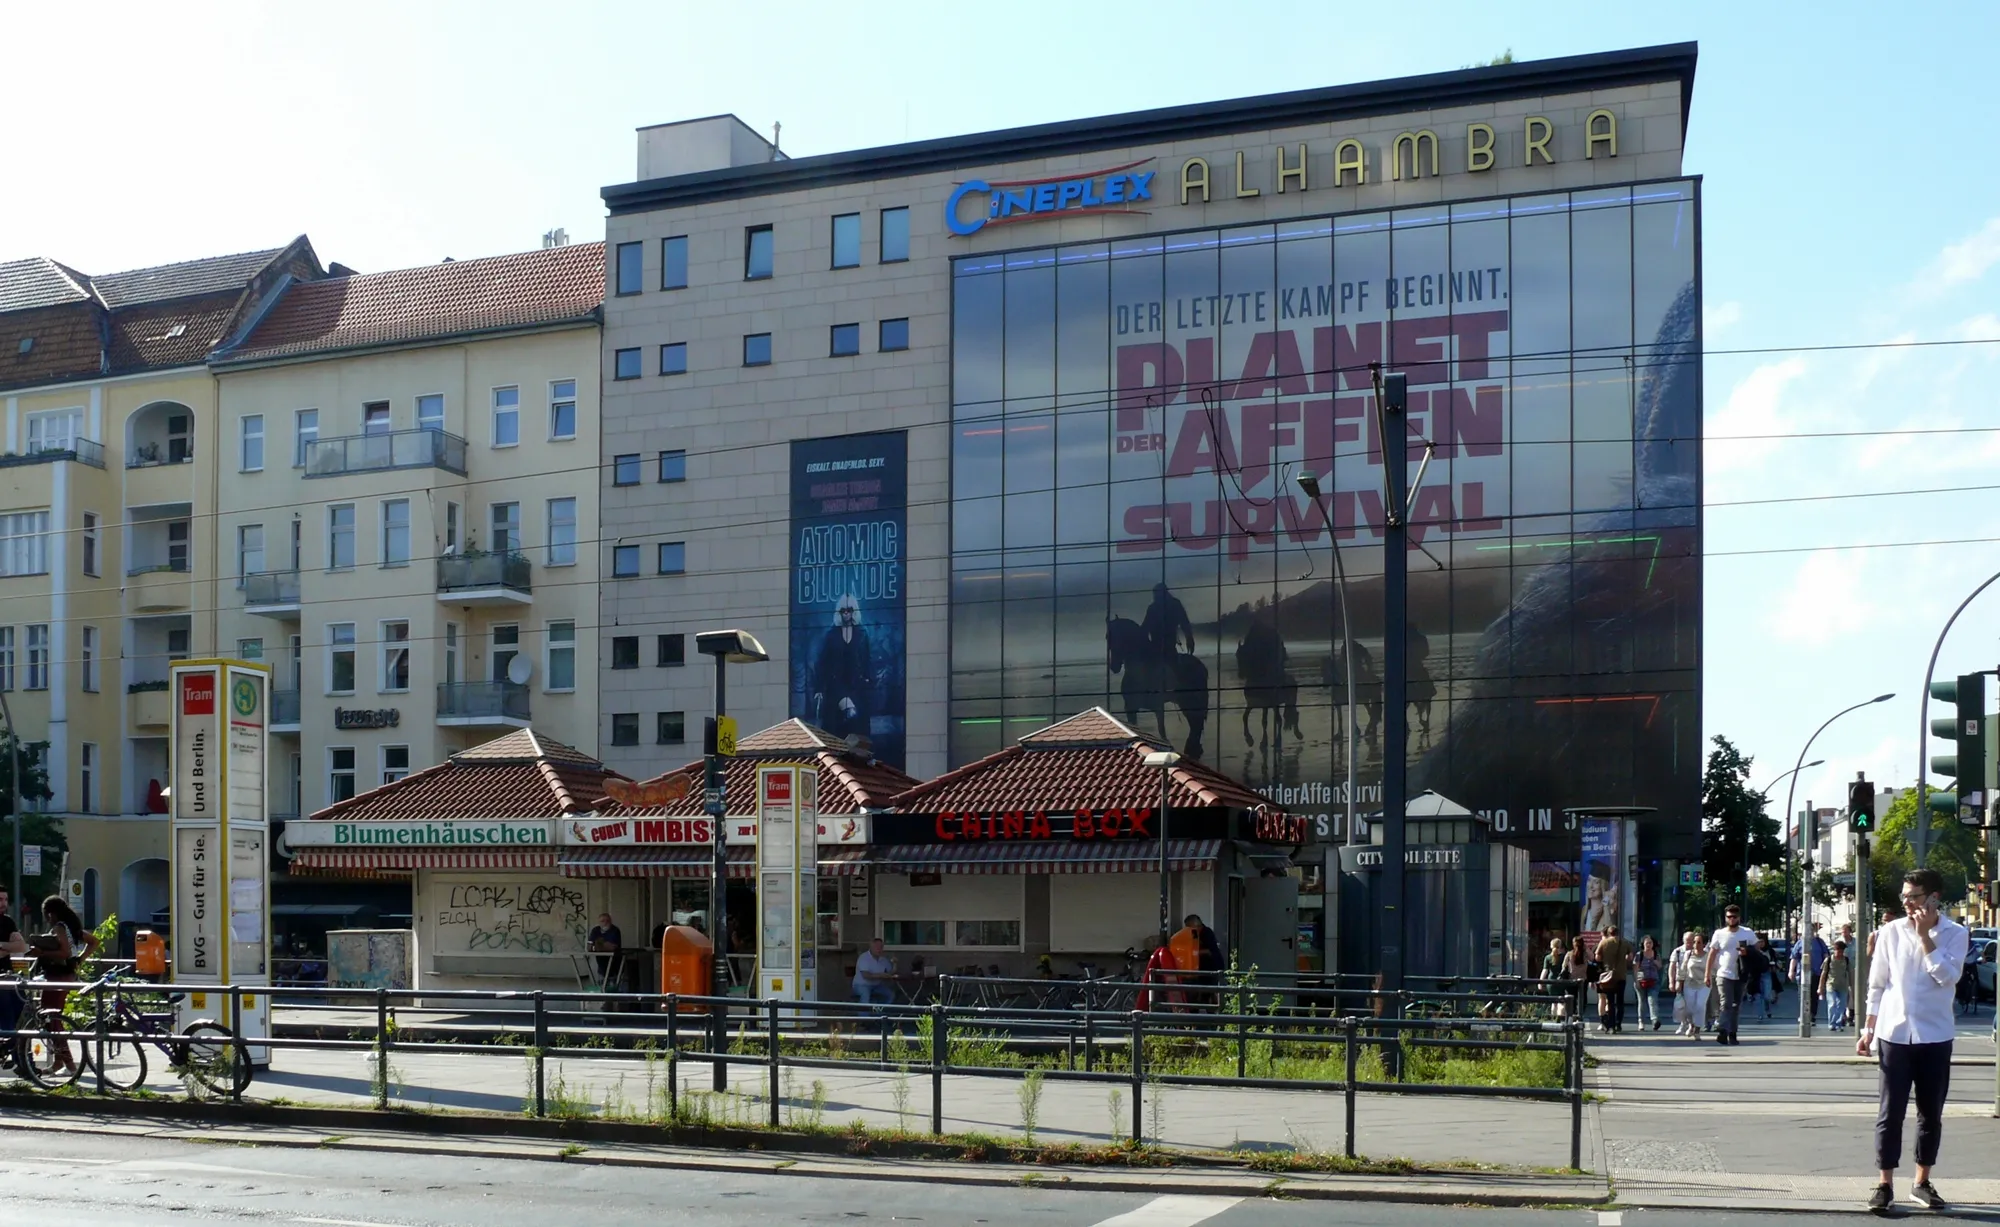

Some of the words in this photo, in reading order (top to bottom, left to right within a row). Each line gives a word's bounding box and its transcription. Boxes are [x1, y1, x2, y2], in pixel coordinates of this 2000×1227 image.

[1180, 108, 1618, 205] ALHAMBRA
[944, 170, 1156, 236] CINEPLEX
[1117, 303, 1162, 335] DER
[1177, 291, 1266, 330] LETZTE
[1281, 280, 1370, 319] KAMPF
[1385, 267, 1508, 310] BEGINNT.
[1116, 310, 1508, 432] PLANET
[1116, 433, 1167, 454] DER
[1166, 385, 1503, 497] AFFEN
[806, 462, 831, 473] EISKALT.
[868, 457, 885, 468] SEXY.
[1116, 482, 1503, 561] SURVIVAL
[800, 521, 897, 565] ATOMIC
[798, 560, 897, 604] BLONDE
[184, 687, 213, 701] Tram
[192, 728, 205, 777] Berlin.
[192, 782, 205, 813] Und
[768, 780, 790, 790] Tram
[334, 822, 547, 845] Blumenhäuschen
[591, 821, 627, 844] CURRY
[633, 820, 715, 843] IMBIS
[935, 810, 1051, 841] CHINA
[1073, 808, 1151, 841] BOX
[1528, 807, 1552, 831] IN
[193, 834, 205, 861] Sie.
[1356, 851, 1383, 866] CITY
[192, 865, 205, 889] für
[193, 891, 205, 920] Gut
[193, 936, 206, 969] BVG
